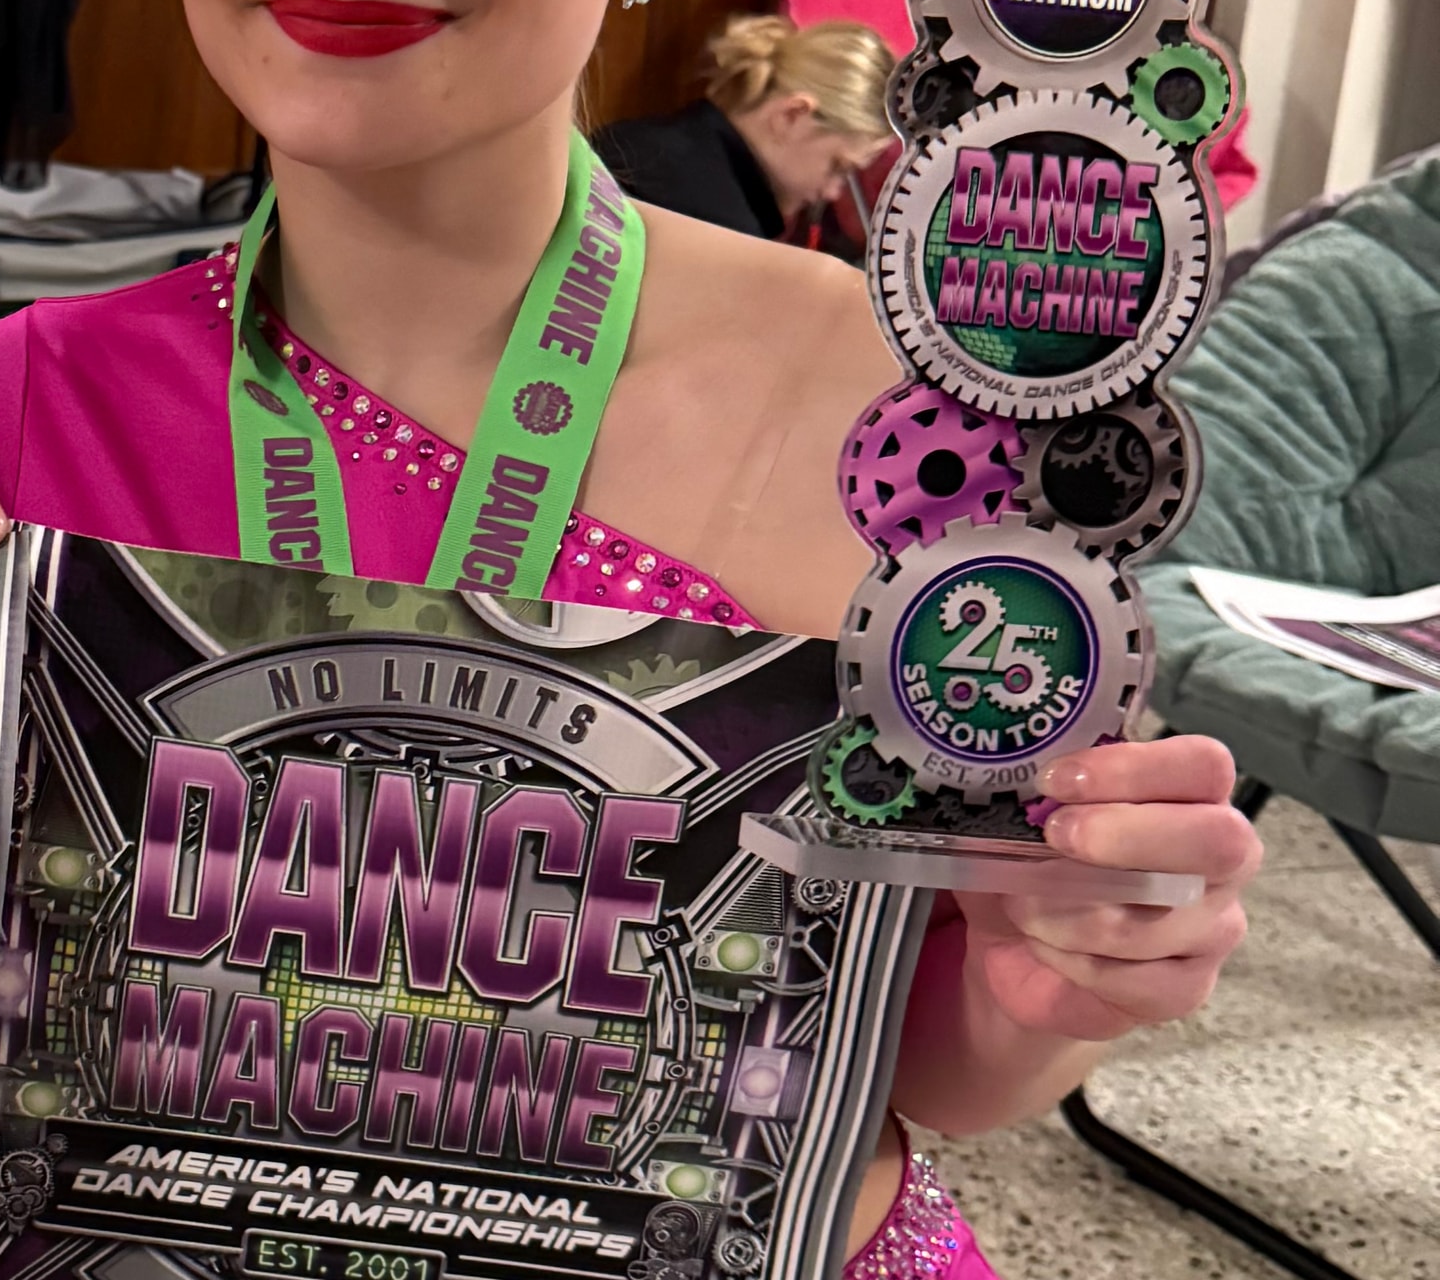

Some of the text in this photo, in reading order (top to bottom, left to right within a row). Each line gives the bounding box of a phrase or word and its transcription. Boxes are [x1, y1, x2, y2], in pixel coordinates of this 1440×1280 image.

[947, 147, 1160, 260] DANCE
[538, 167, 625, 367] MACHINE
[936, 256, 1145, 339] MACHINE
[931, 340, 1016, 397] NATIONAL
[1024, 377, 1094, 399] DANCE
[268, 658, 600, 746] NO LIMITS
[903, 663, 1084, 752] SEASON TOUR
[922, 751, 972, 784] EST.
[128, 735, 690, 1018] DANCE
[110, 976, 641, 1172] MACHINE
[72, 1167, 635, 1259] DANCE CHAMPIONSHIPS
[105, 1144, 601, 1226] AMERICA'S NATIONAL
[258, 1238, 329, 1275] EST.
